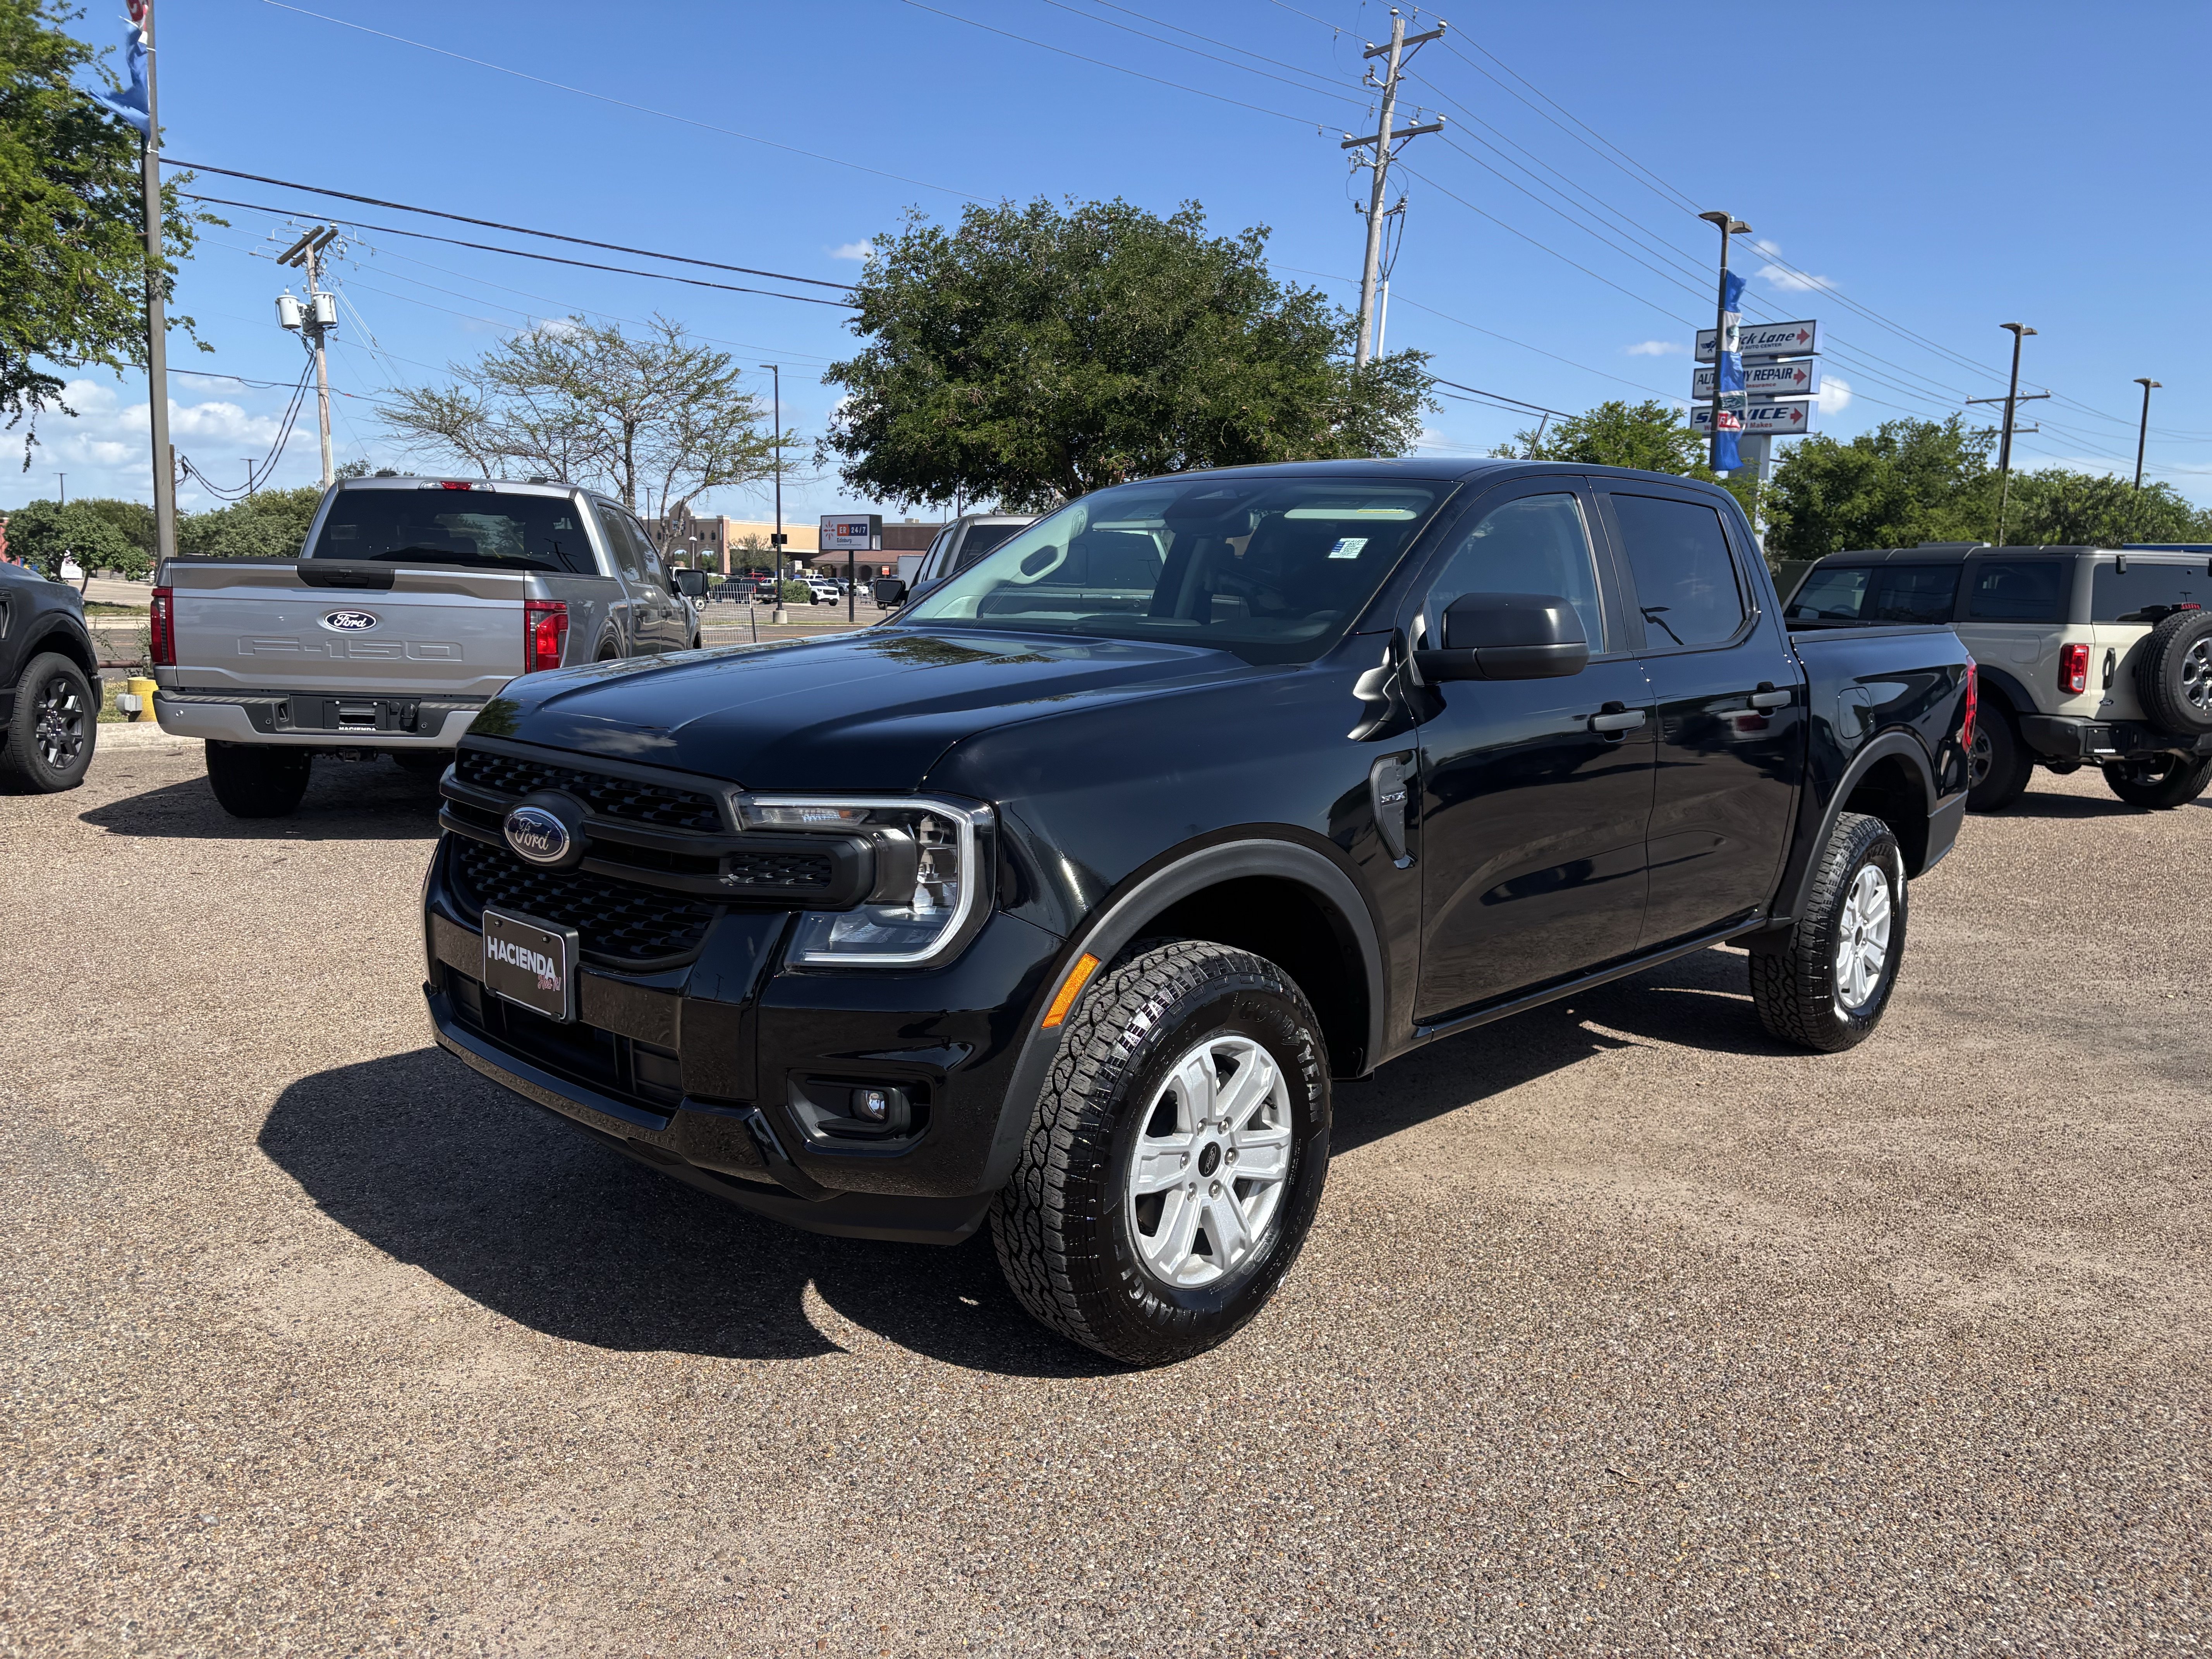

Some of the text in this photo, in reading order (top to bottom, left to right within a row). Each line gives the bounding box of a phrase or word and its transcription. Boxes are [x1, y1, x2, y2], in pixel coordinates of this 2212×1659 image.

[1758, 332, 1795, 343] Lane
[1753, 368, 1793, 381] REPAIR
[333, 613, 368, 628] Ford
[237, 635, 463, 661] F-150
[515, 817, 552, 851] Ford
[487, 935, 556, 983] HACIENDA
[1239, 999, 1324, 1123] GOODYEAR
[1206, 1150, 1215, 1170] Ford
